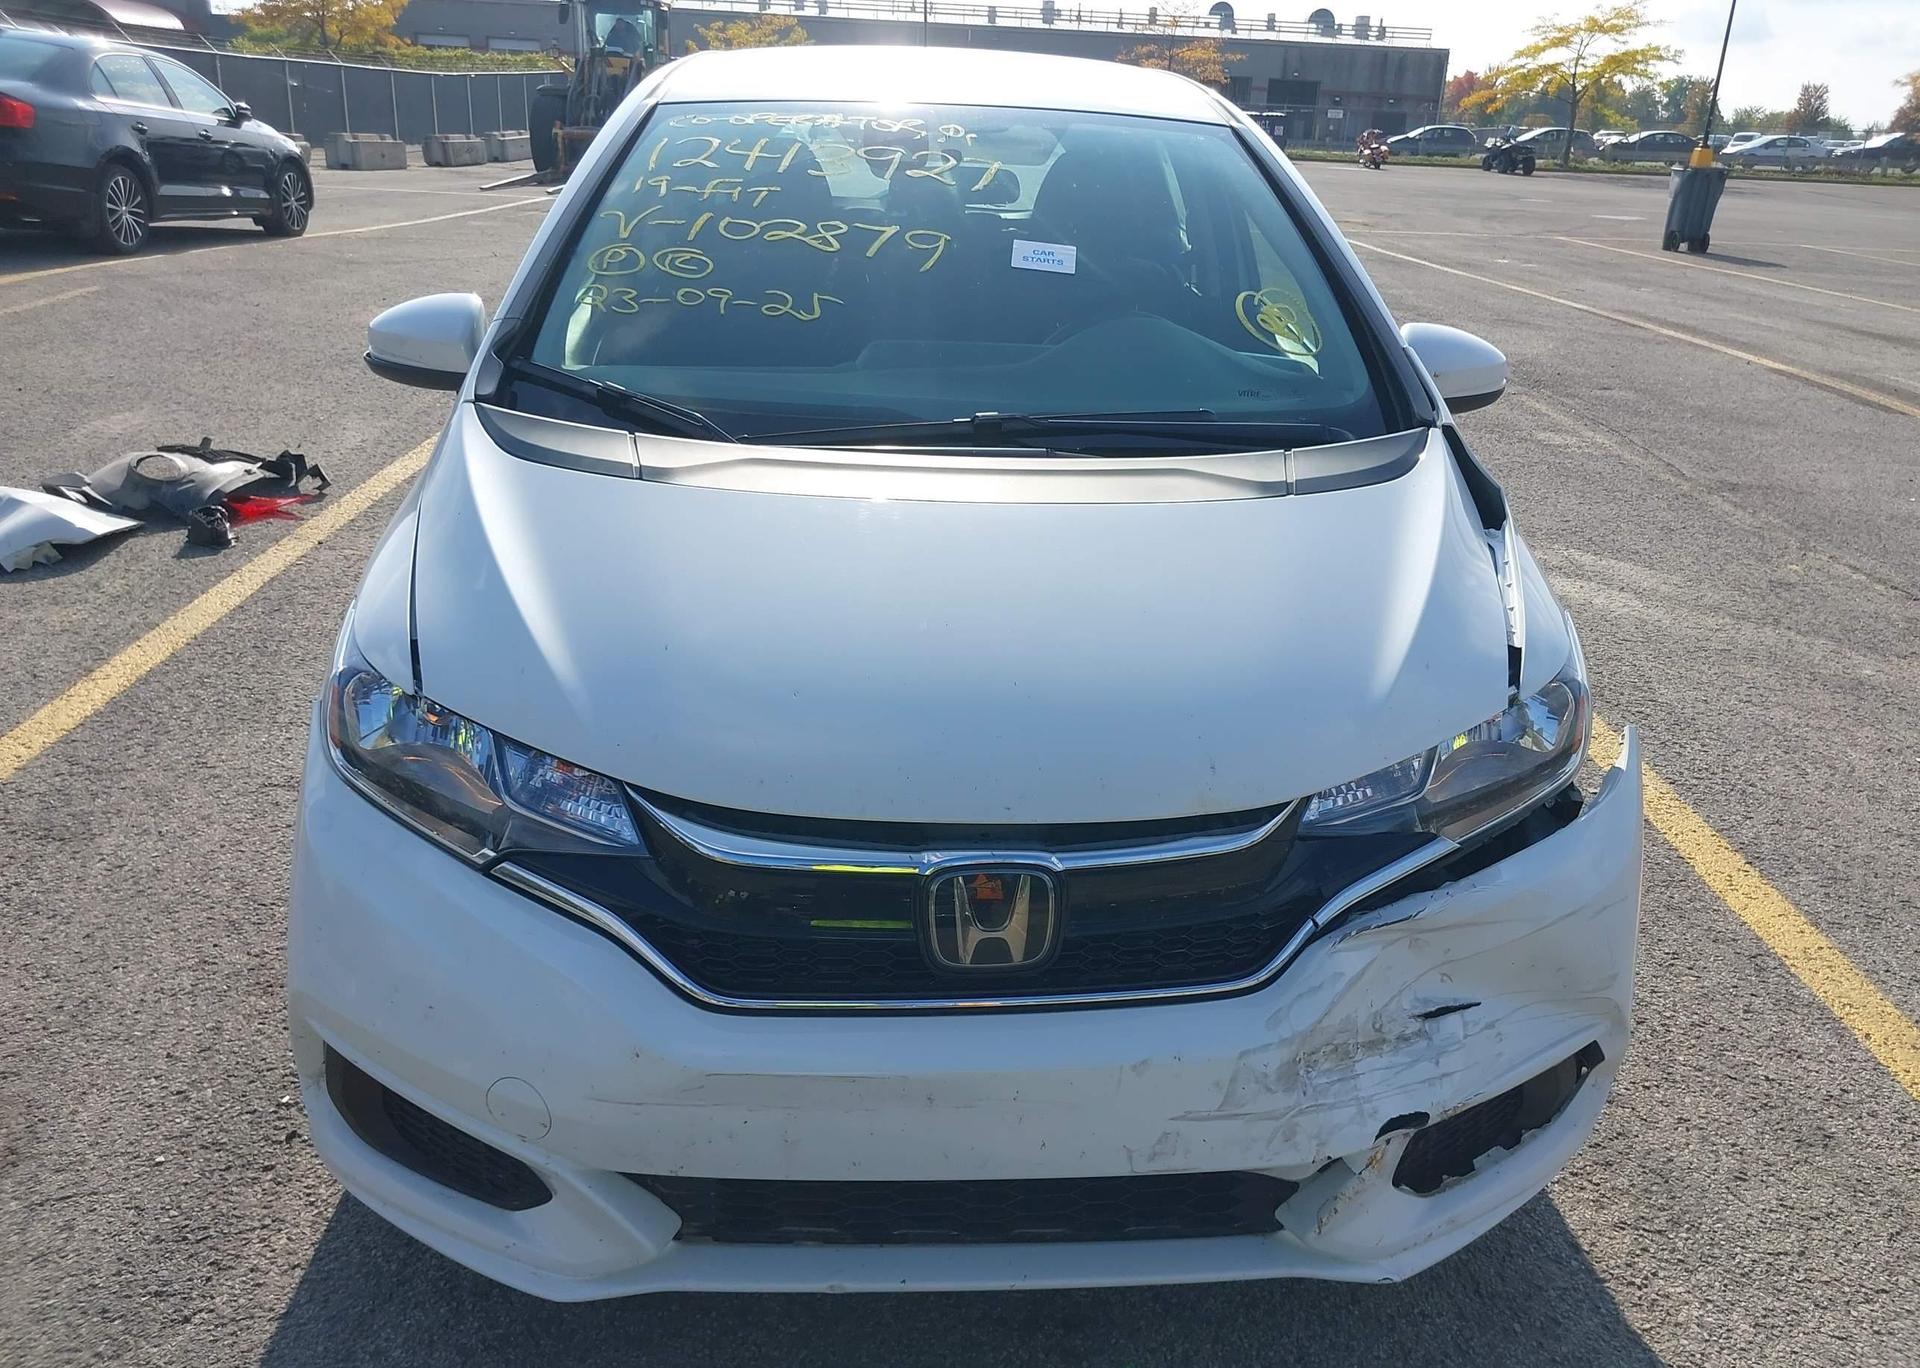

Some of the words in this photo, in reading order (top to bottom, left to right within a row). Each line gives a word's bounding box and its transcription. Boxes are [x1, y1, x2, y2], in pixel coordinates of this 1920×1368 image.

[600, 205, 952, 273] V-102879
[1032, 249, 1056, 258] CAR
[1021, 255, 1065, 267] STARTS
